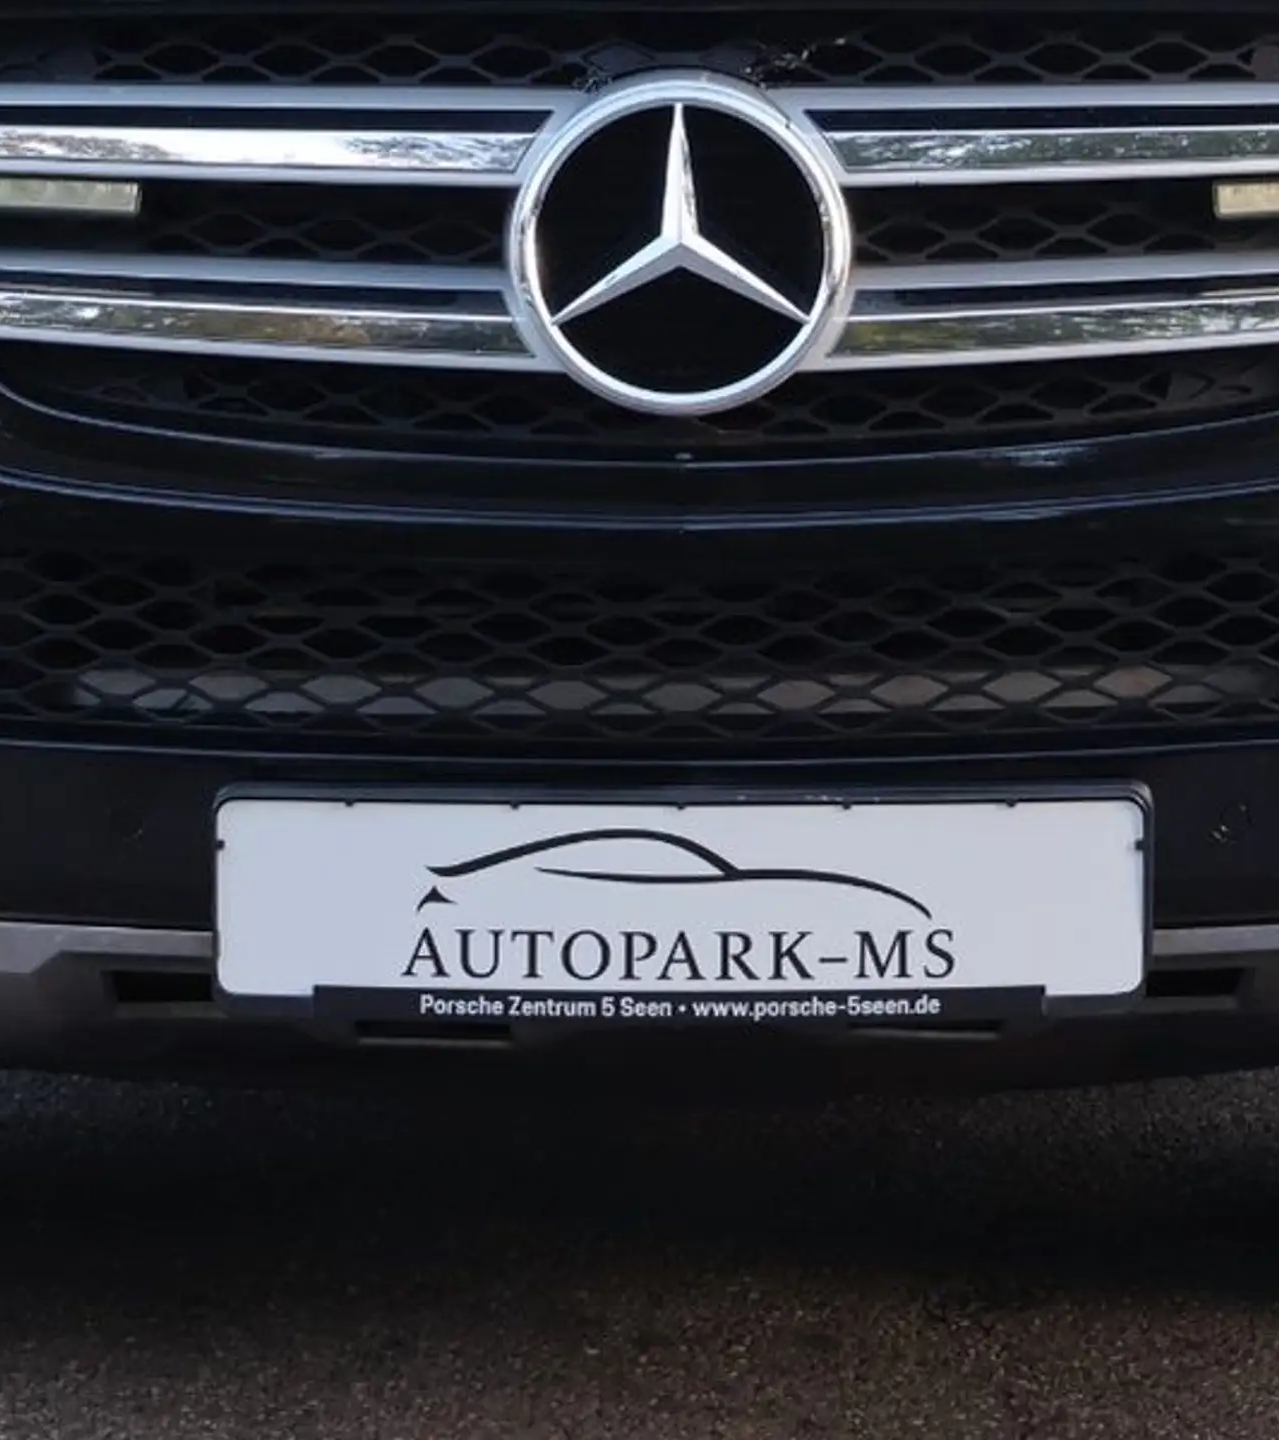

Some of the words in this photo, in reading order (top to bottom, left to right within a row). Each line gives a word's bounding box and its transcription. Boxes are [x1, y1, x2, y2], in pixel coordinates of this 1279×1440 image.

[400, 926, 956, 981] AUTOPARK-MS
[419, 994, 504, 1016] Porsche
[507, 995, 597, 1017] Zentrum
[600, 996, 616, 1017] 5
[620, 996, 672, 1017] Seen
[692, 994, 941, 1022] www.porsche-5seen.de
